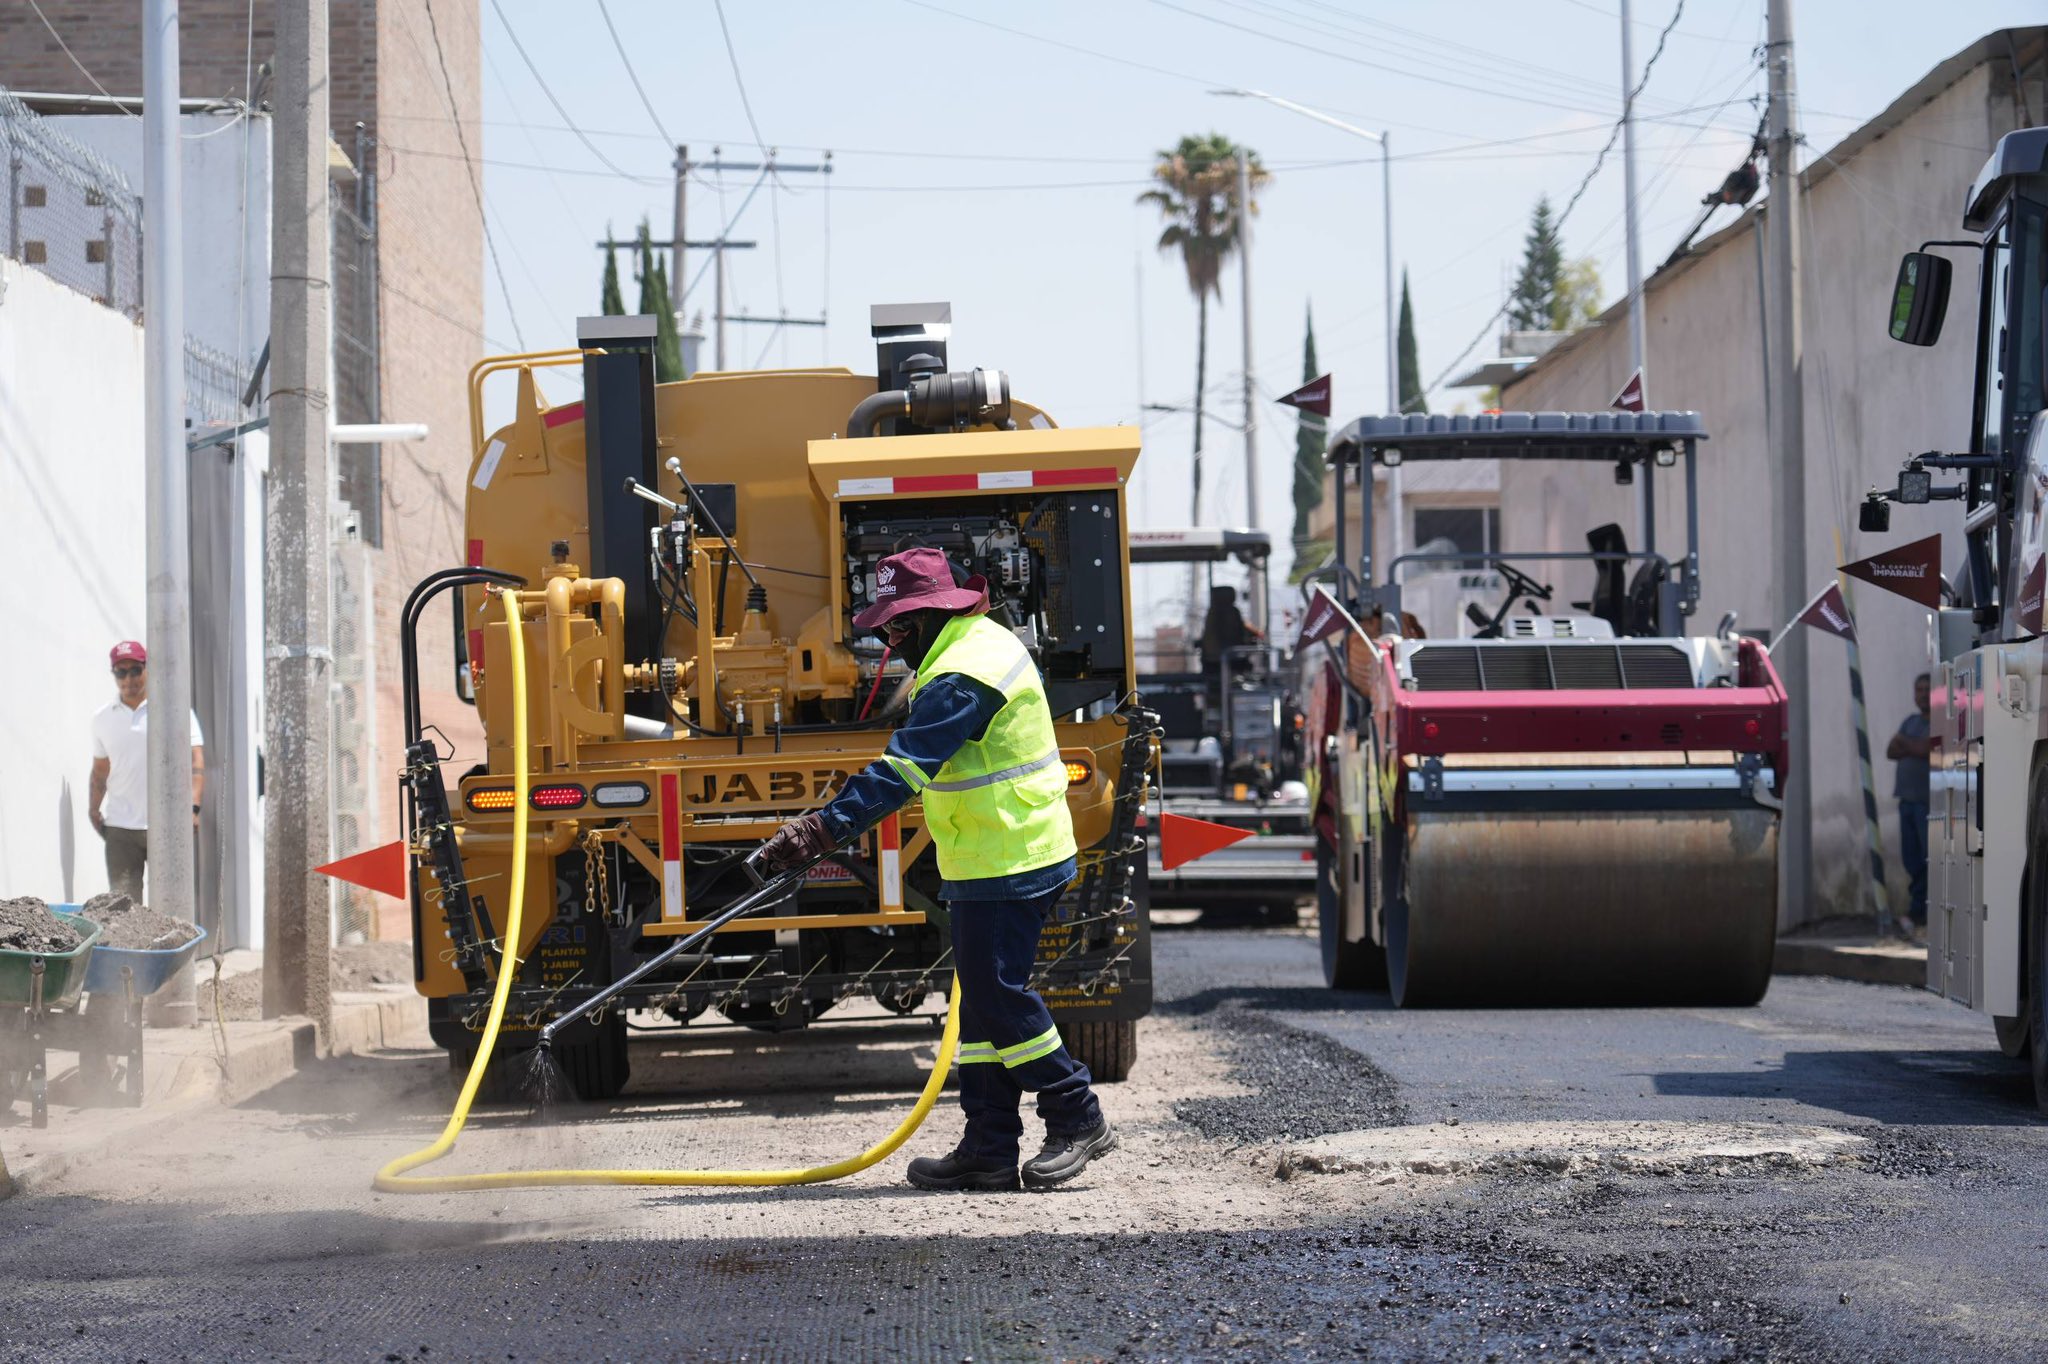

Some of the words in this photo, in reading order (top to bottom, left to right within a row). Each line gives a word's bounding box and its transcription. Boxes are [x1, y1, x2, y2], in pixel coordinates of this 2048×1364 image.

[1873, 568, 1925, 578] IMPARABLE
[686, 768, 864, 804] JABR
[807, 866, 853, 879] ONHE
